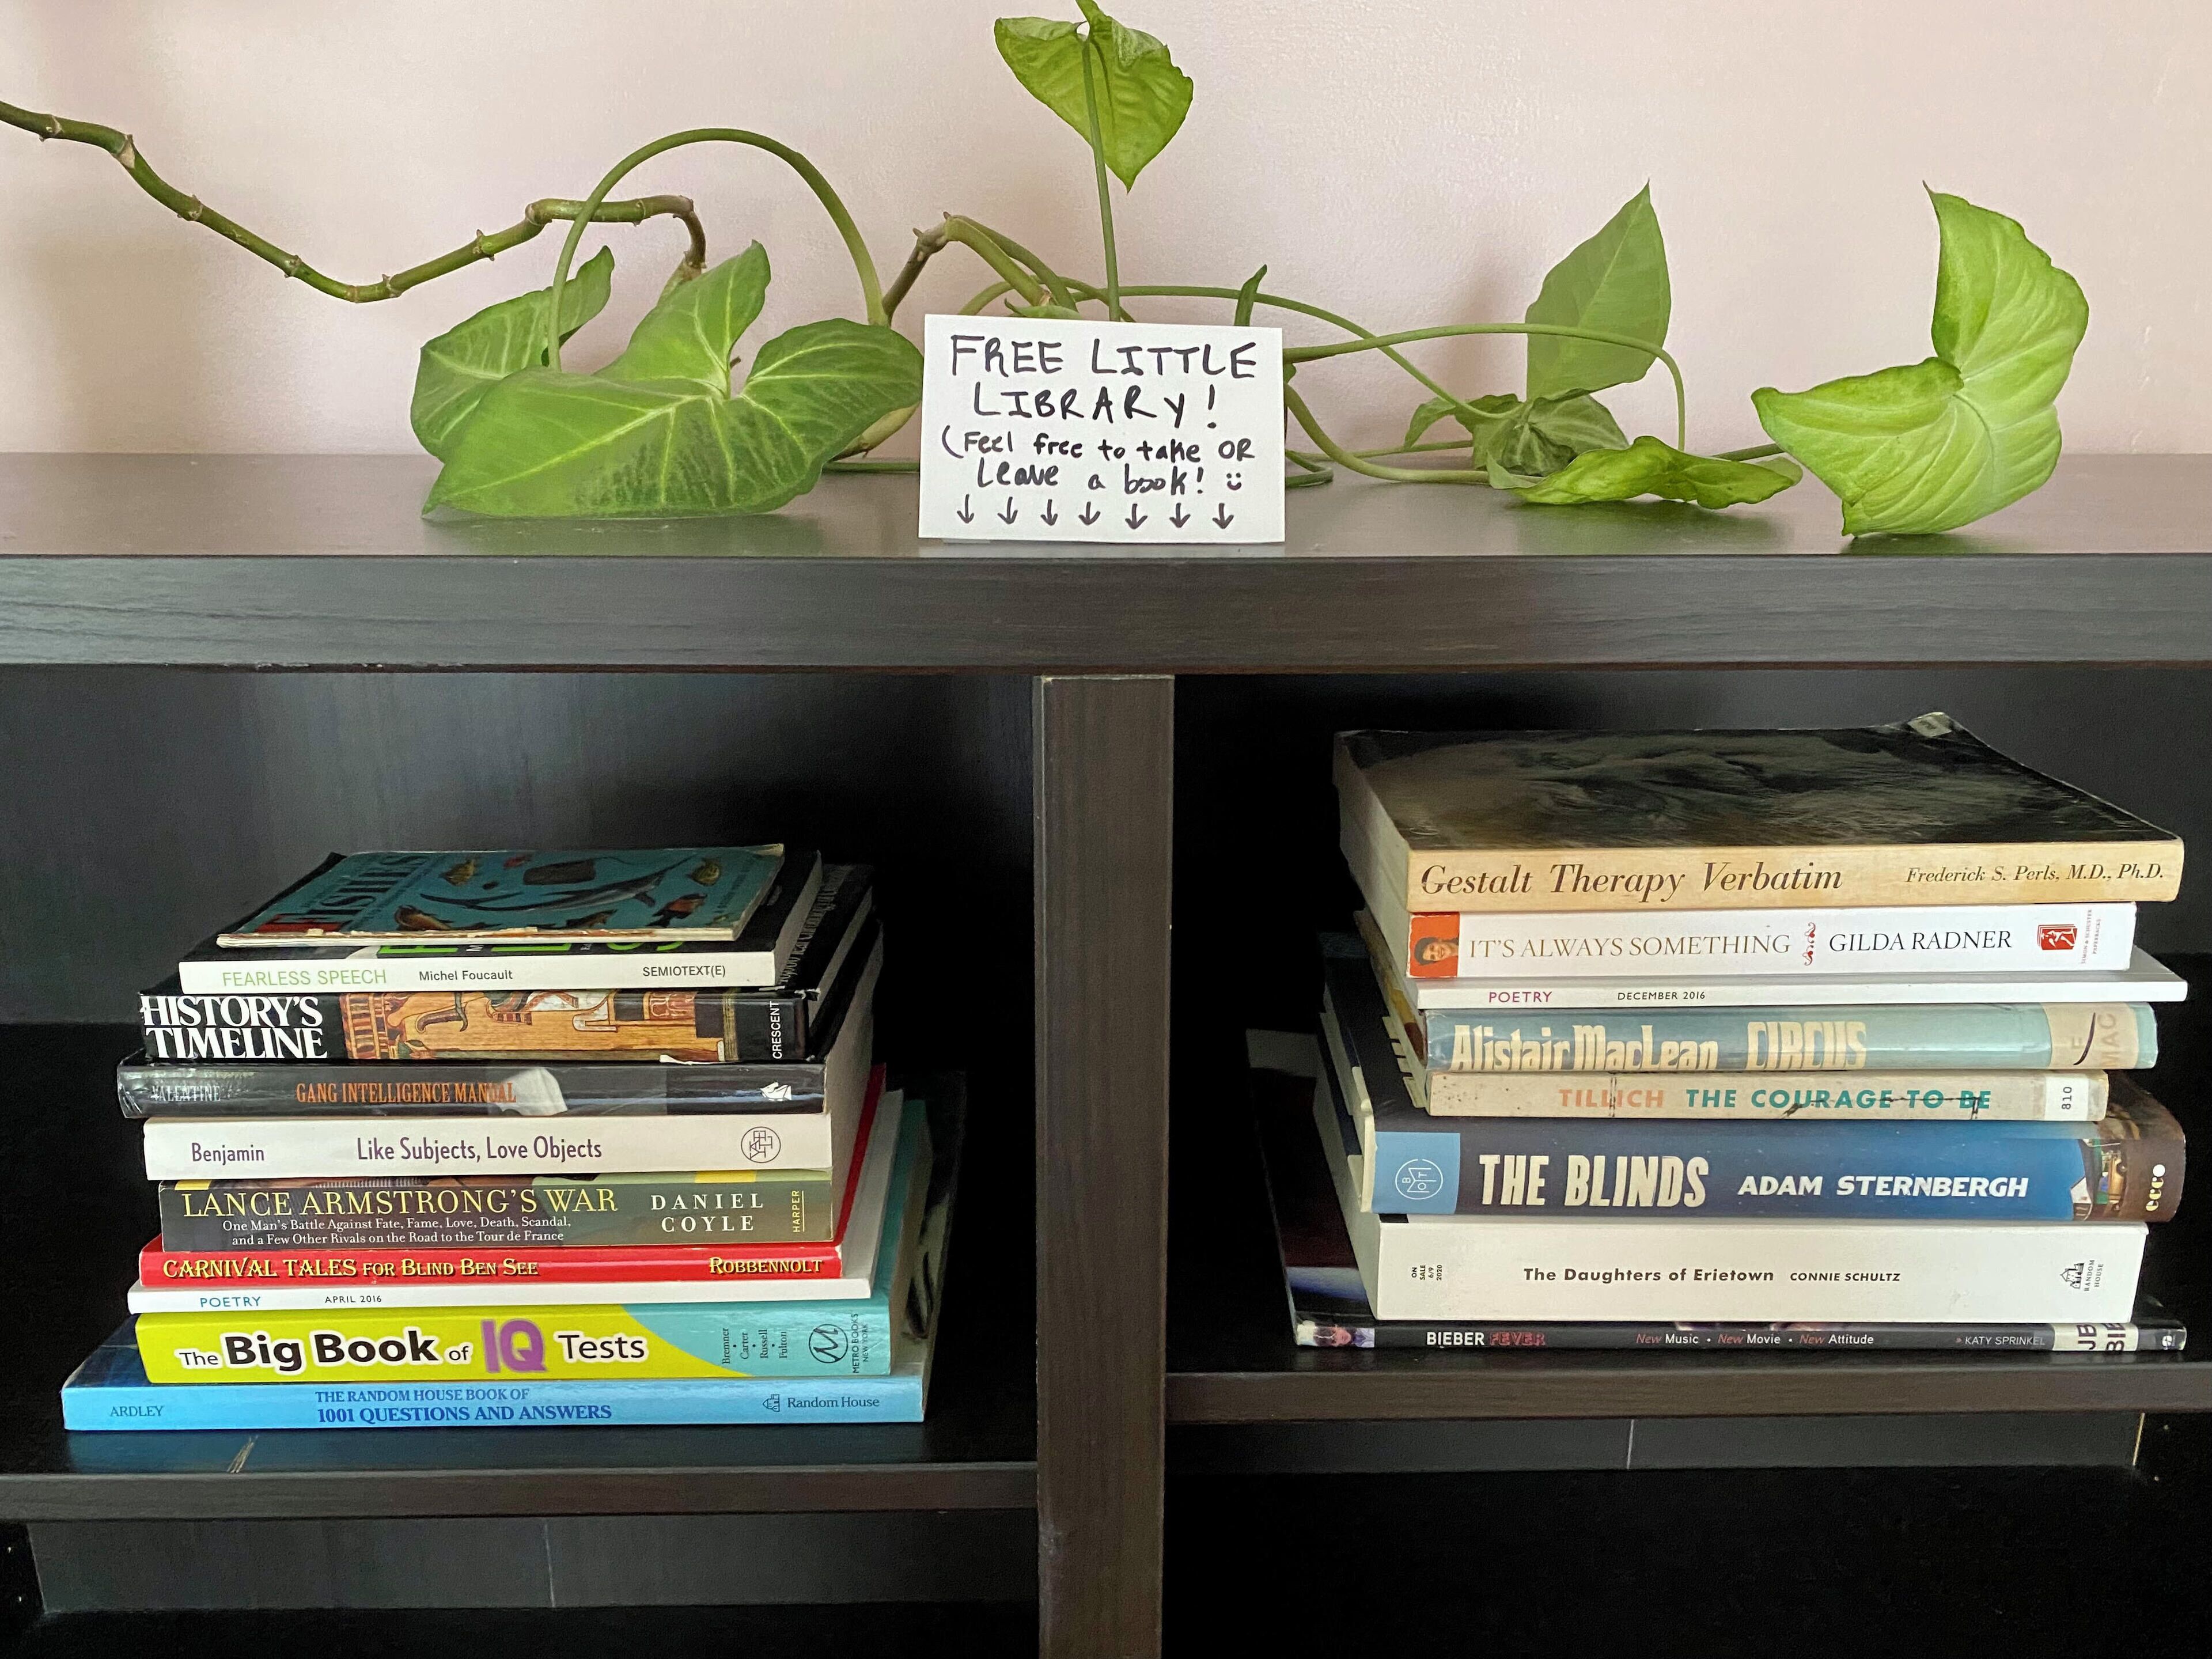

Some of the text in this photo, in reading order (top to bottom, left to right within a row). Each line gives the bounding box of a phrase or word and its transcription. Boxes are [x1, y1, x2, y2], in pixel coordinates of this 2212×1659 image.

[950, 335, 1256, 378] FREE LITTLE
[942, 425, 1255, 463] (Feel free to take OR
[1088, 474, 1107, 490] a
[1124, 464, 1204, 495] book!
[1421, 861, 1843, 903] Gestalt Therapy Verbatim
[1905, 863, 2164, 883] Frederick S. Perls, M.D., Ph.D.
[1469, 934, 1790, 959] IT'S ALWAYS SOMETHING
[1829, 930, 2013, 952] GILDA RADNER
[222, 969, 387, 987] FEARLESS SPEECH
[419, 969, 513, 982] Michel Foucault
[642, 965, 726, 978] SEMIOTEXT(E)
[1488, 991, 1552, 1003] POETRY
[1617, 991, 1706, 1001] DECEMBER 2016
[140, 995, 323, 1028] HISTORY'S
[770, 1000, 782, 1060] CRESCENT
[146, 1027, 328, 1059] TIMELINE
[1448, 1025, 1718, 1071] Alistair MacLean
[1746, 1021, 1867, 1070] CIRCUS
[151, 1085, 221, 1102] VALENTINE
[296, 1082, 517, 1103] GANG INTELLIGENCE MANUAL
[1559, 1089, 1665, 1108] TILLICH
[1686, 1089, 1991, 1109] THE COURAGE TO BE
[2061, 1086, 2072, 1109] 810
[191, 1142, 264, 1165] Benjamin
[357, 1136, 602, 1164] Like Subjects, Love Objects
[1479, 1154, 1709, 1207] THE BLINDS
[1738, 1175, 2028, 1198] ADAM STERNBERGH
[181, 1188, 618, 1218] LANCE ARMSTRONG'S WAR
[651, 1193, 764, 1211] DANIEL
[791, 1190, 801, 1233] HARPER
[222, 1216, 571, 1232] One Man's Battle Against Fate, Fame, Love, Death, Scandal,
[661, 1215, 755, 1233] COYLE
[232, 1234, 255, 1245] and
[267, 1234, 290, 1244] Few
[293, 1233, 328, 1244] Other
[330, 1233, 366, 1244] Rivals
[386, 1233, 406, 1243] the
[408, 1232, 438, 1243] Road
[441, 1234, 453, 1243] to
[455, 1232, 474, 1242] the
[476, 1232, 504, 1242] Tour
[507, 1230, 521, 1241] de
[524, 1230, 565, 1241] France
[162, 1257, 278, 1278] CARNIVAL
[282, 1258, 357, 1278] TALES
[363, 1262, 396, 1277] FOR
[1411, 1267, 1417, 1278] ON
[1524, 1268, 1774, 1284] The Daughters of Erietown
[1790, 1272, 1901, 1282] CONNIE SCHULTZ
[2084, 1260, 2095, 1291] RANDOM
[2094, 1264, 2104, 1287] HOUSE
[200, 1296, 261, 1308] POETRY
[324, 1294, 382, 1304] APRIL 2016
[179, 1318, 646, 1374] The Big Book of IQ Tests
[722, 1328, 730, 1365] Bremner
[740, 1332, 749, 1359] Carter
[760, 1329, 768, 1359] Russell
[779, 1331, 787, 1359] Fulton
[1426, 1331, 1546, 1347] BIEBER FEVER
[1636, 1334, 1699, 1344] New Music
[1717, 1333, 1781, 1345] New Movie
[1800, 1334, 1874, 1345] New Attitude
[1964, 1336, 2046, 1346] KATY SPRINKEL
[315, 1388, 530, 1403] THE RANDOM HOUSE BOOK OF
[787, 1396, 880, 1408] Random House
[110, 1406, 165, 1417] ARDLEY
[317, 1405, 612, 1425] 1001 QUESTIONS AND ANSWERS
